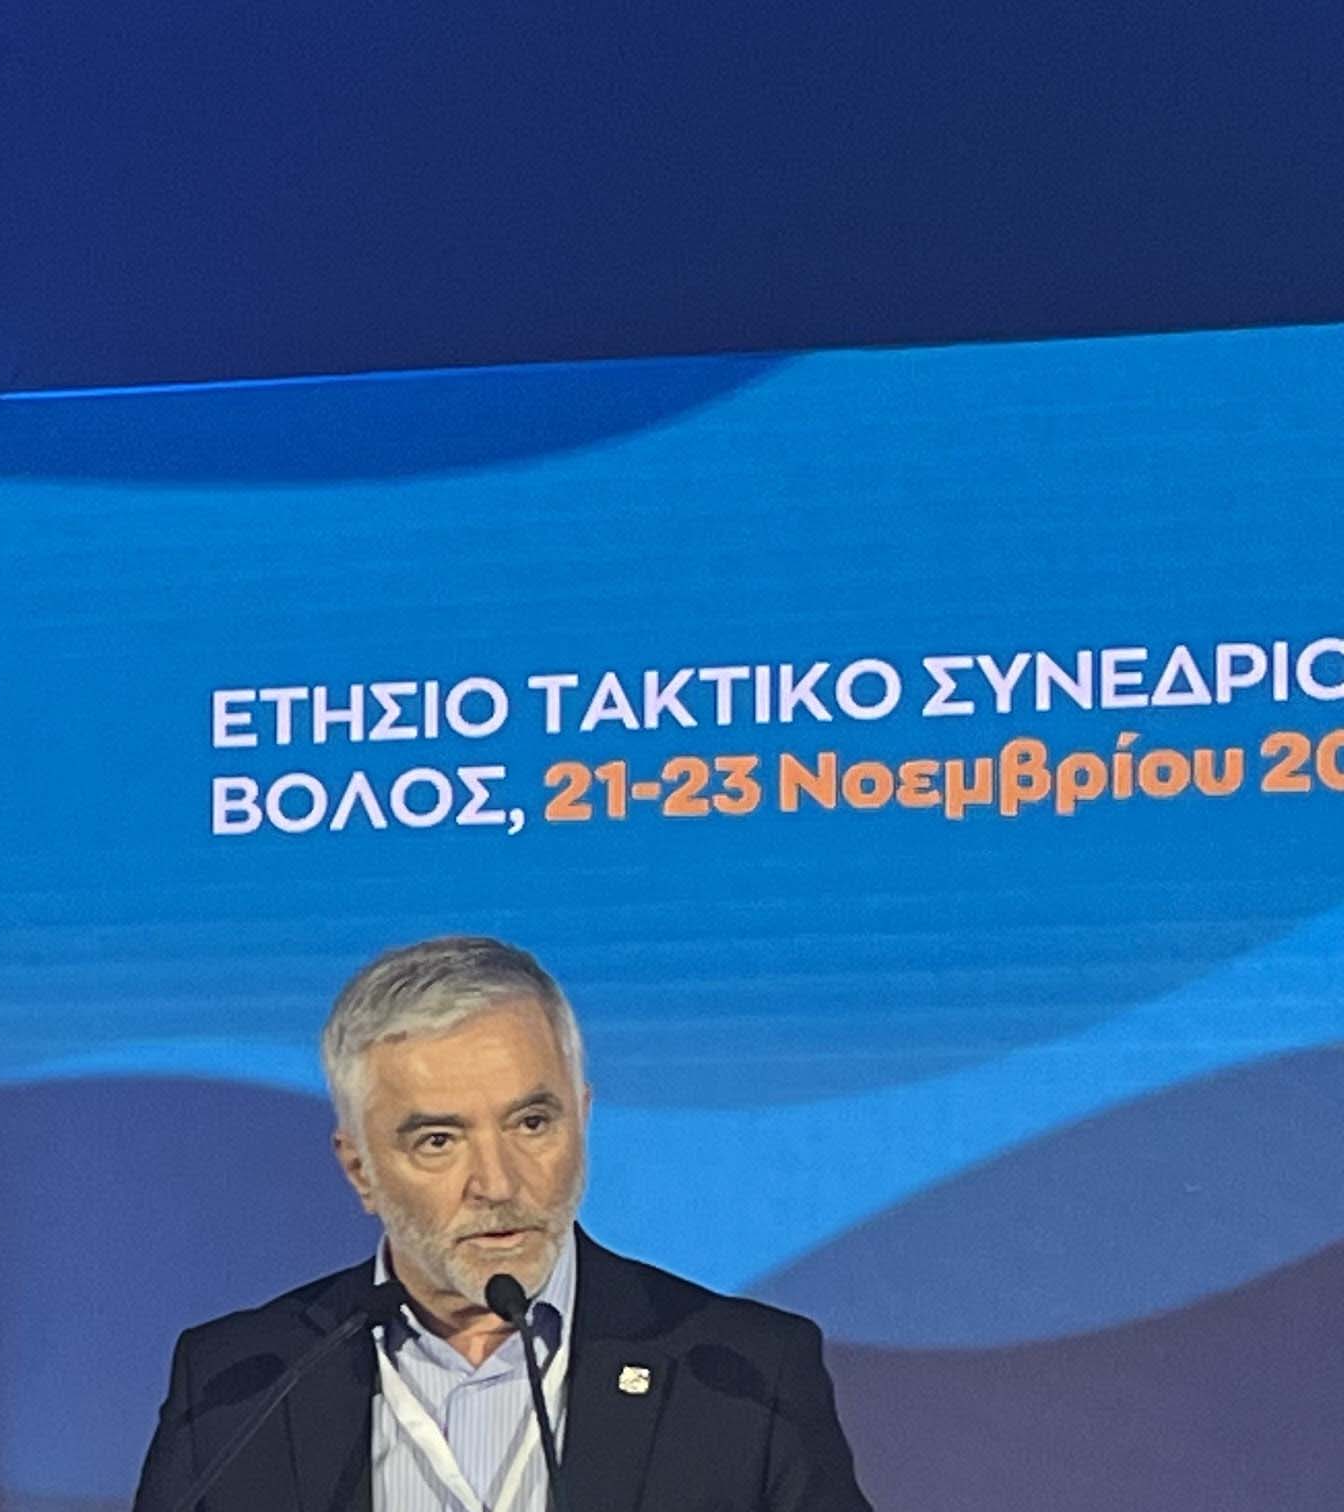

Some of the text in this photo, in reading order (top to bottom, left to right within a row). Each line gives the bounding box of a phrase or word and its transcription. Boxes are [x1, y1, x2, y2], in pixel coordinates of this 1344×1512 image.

[212, 677, 509, 748] ΕΤΗΣΙΟ
[527, 658, 903, 735] ΤΑΚΤΙΚΟ
[212, 764, 526, 836] ΒΟΛΟΣ,
[543, 753, 762, 821] 21-23
[778, 731, 1245, 820] Νοεμβρίου
